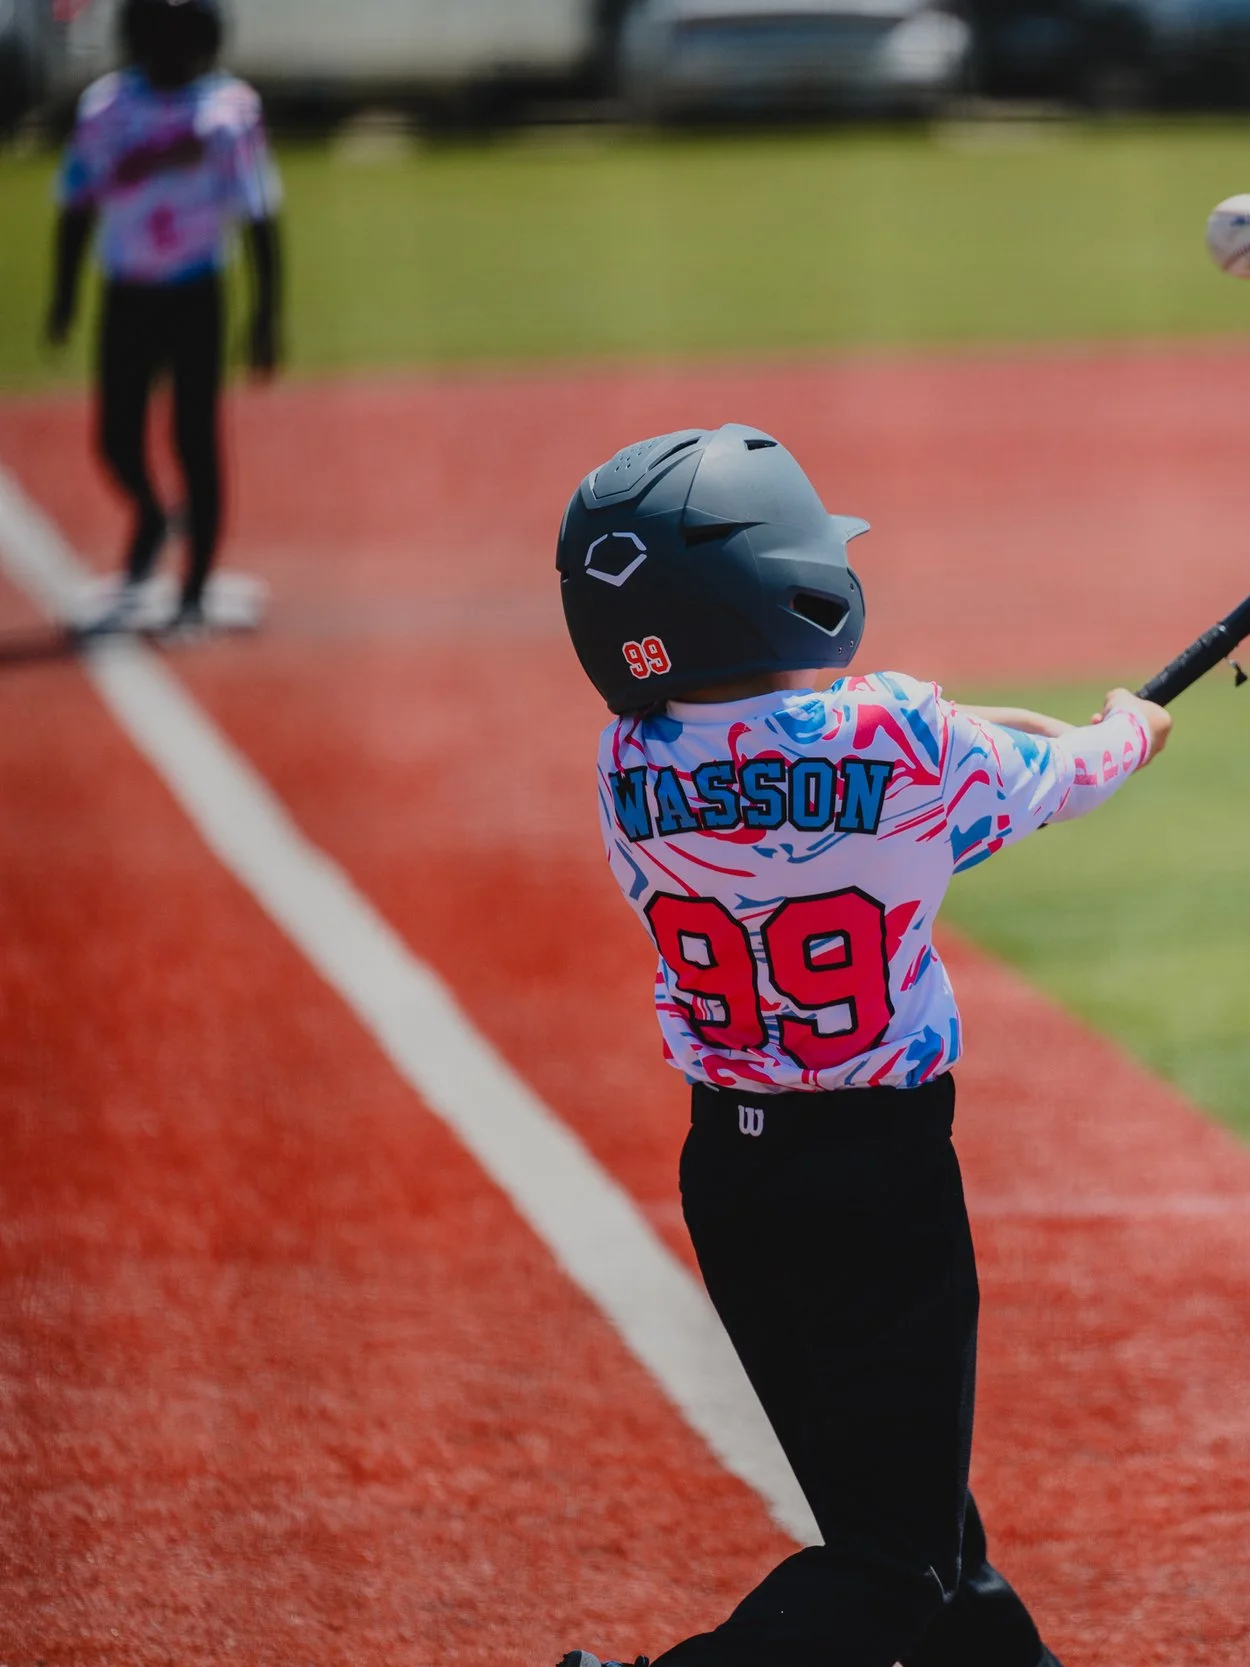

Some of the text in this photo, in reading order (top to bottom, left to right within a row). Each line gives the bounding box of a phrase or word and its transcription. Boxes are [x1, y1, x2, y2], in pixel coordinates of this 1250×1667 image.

[622, 635, 672, 680] 99
[608, 757, 894, 843] WASSON
[643, 885, 895, 1070] 99
